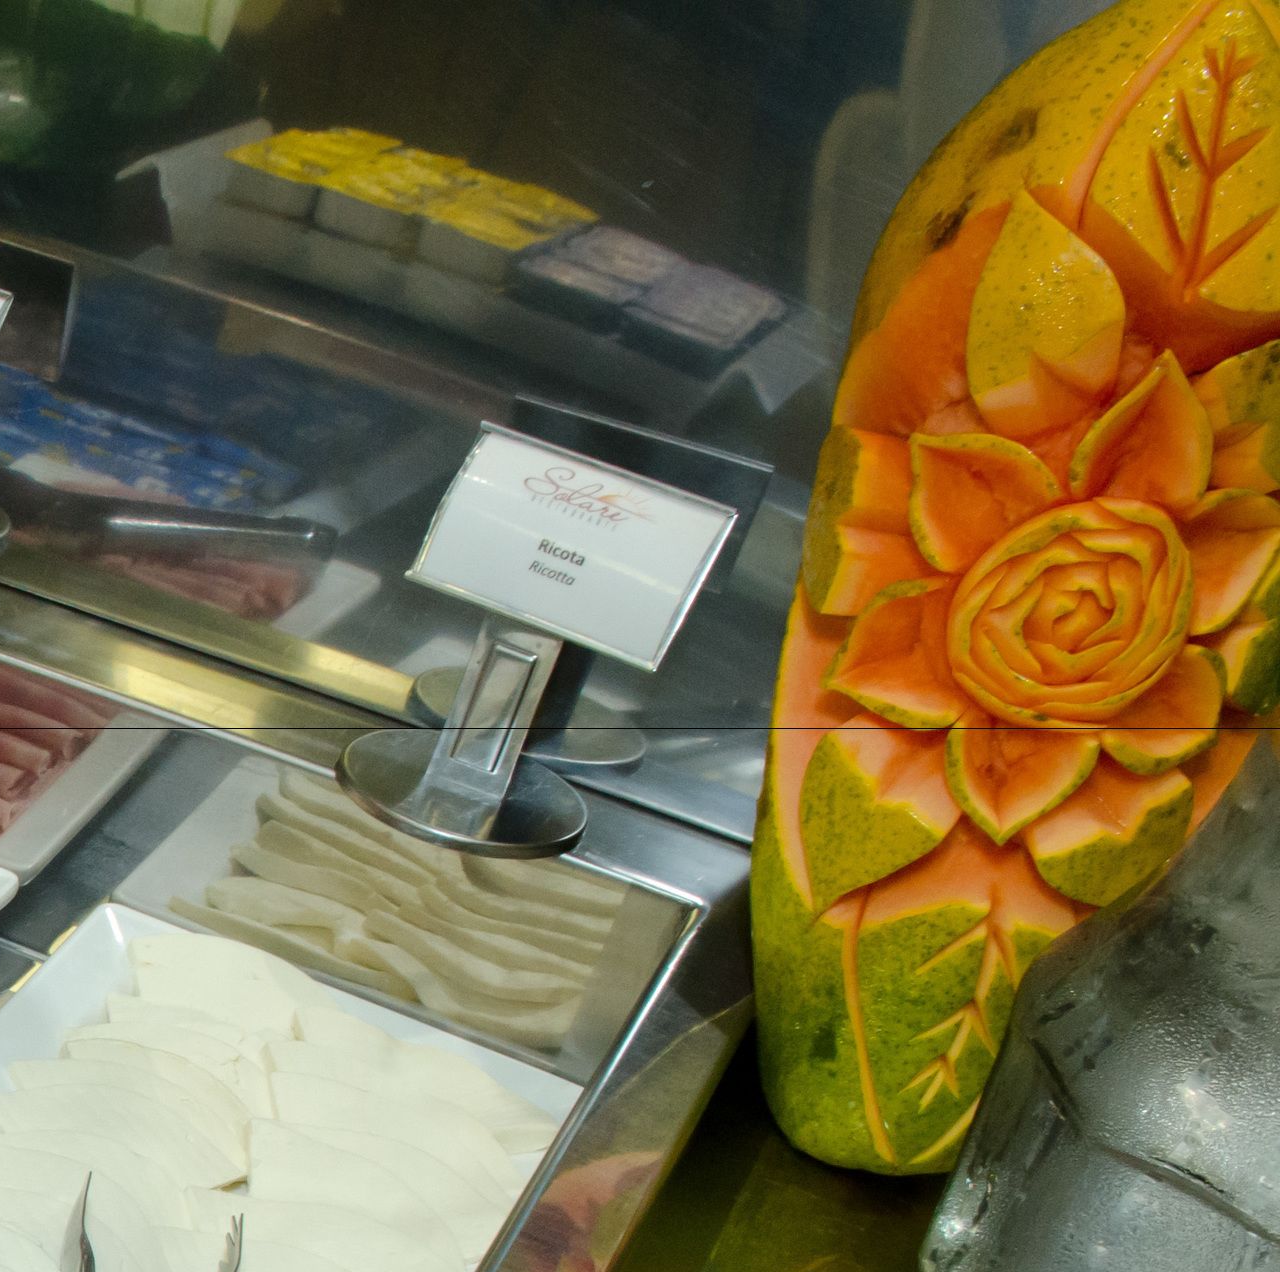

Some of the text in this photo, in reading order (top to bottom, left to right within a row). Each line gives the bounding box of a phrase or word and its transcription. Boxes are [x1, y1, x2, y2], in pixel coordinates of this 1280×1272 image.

[524, 467, 628, 521] Solare
[538, 539, 586, 566] Ricota
[529, 561, 575, 586] Ricotta
